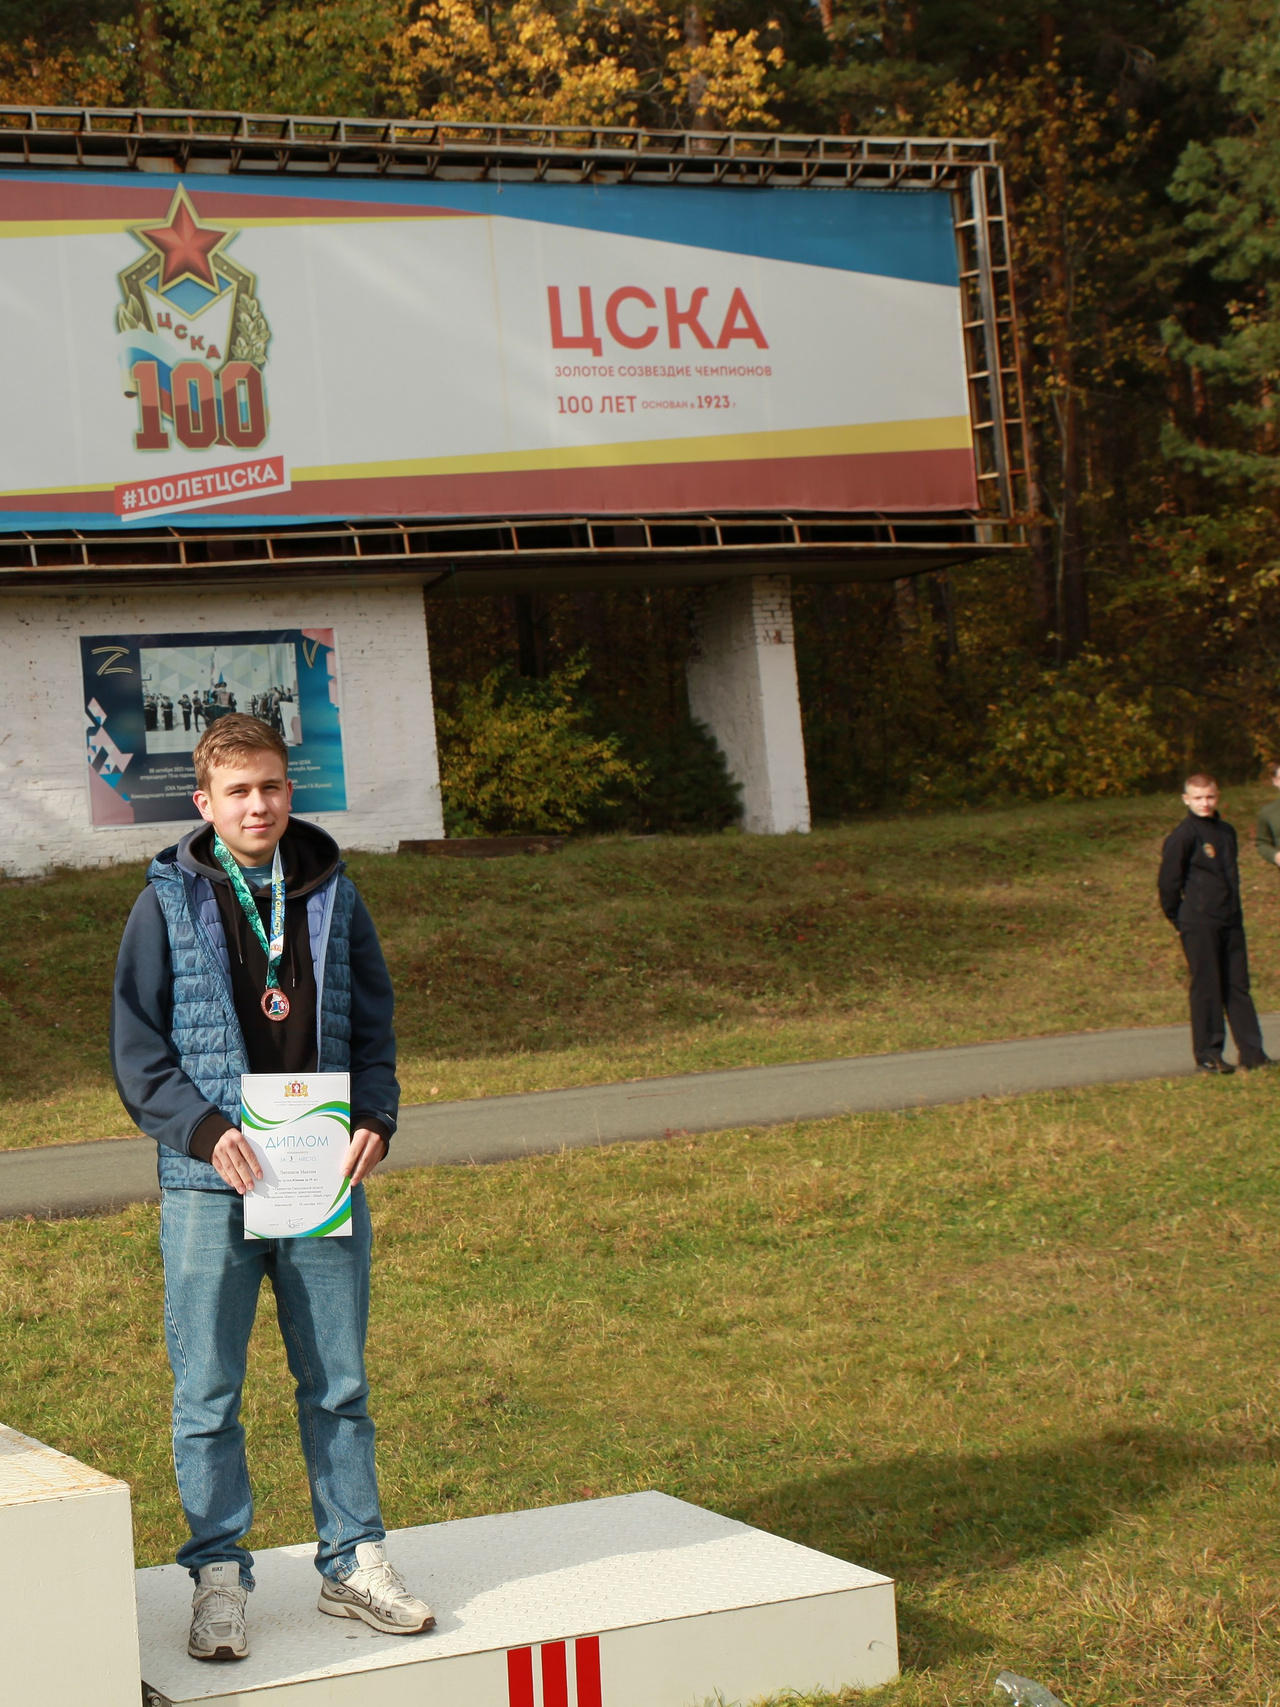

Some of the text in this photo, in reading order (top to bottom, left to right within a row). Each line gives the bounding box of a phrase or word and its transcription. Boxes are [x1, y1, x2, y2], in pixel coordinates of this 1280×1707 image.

[157, 312, 222, 360] ЦСКА
[547, 286, 770, 357] ЦСКА
[554, 365, 773, 378] ЗОЛОТОЕ СОЗВЕЗДИЕ ЧЕМПИОНОВ
[131, 360, 268, 450] 100
[557, 396, 594, 414] 100
[599, 395, 637, 413] ЛЕТ
[641, 400, 688, 409] ОСНОВАН
[697, 395, 730, 409] 1923
[122, 463, 279, 509] #100ЛЕТЦСКА
[91, 646, 133, 676] Z
[302, 638, 320, 668] V
[274, 900, 282, 935] ОБЛАСТЬ
[265, 1135, 329, 1149] ДИПЛОМ
